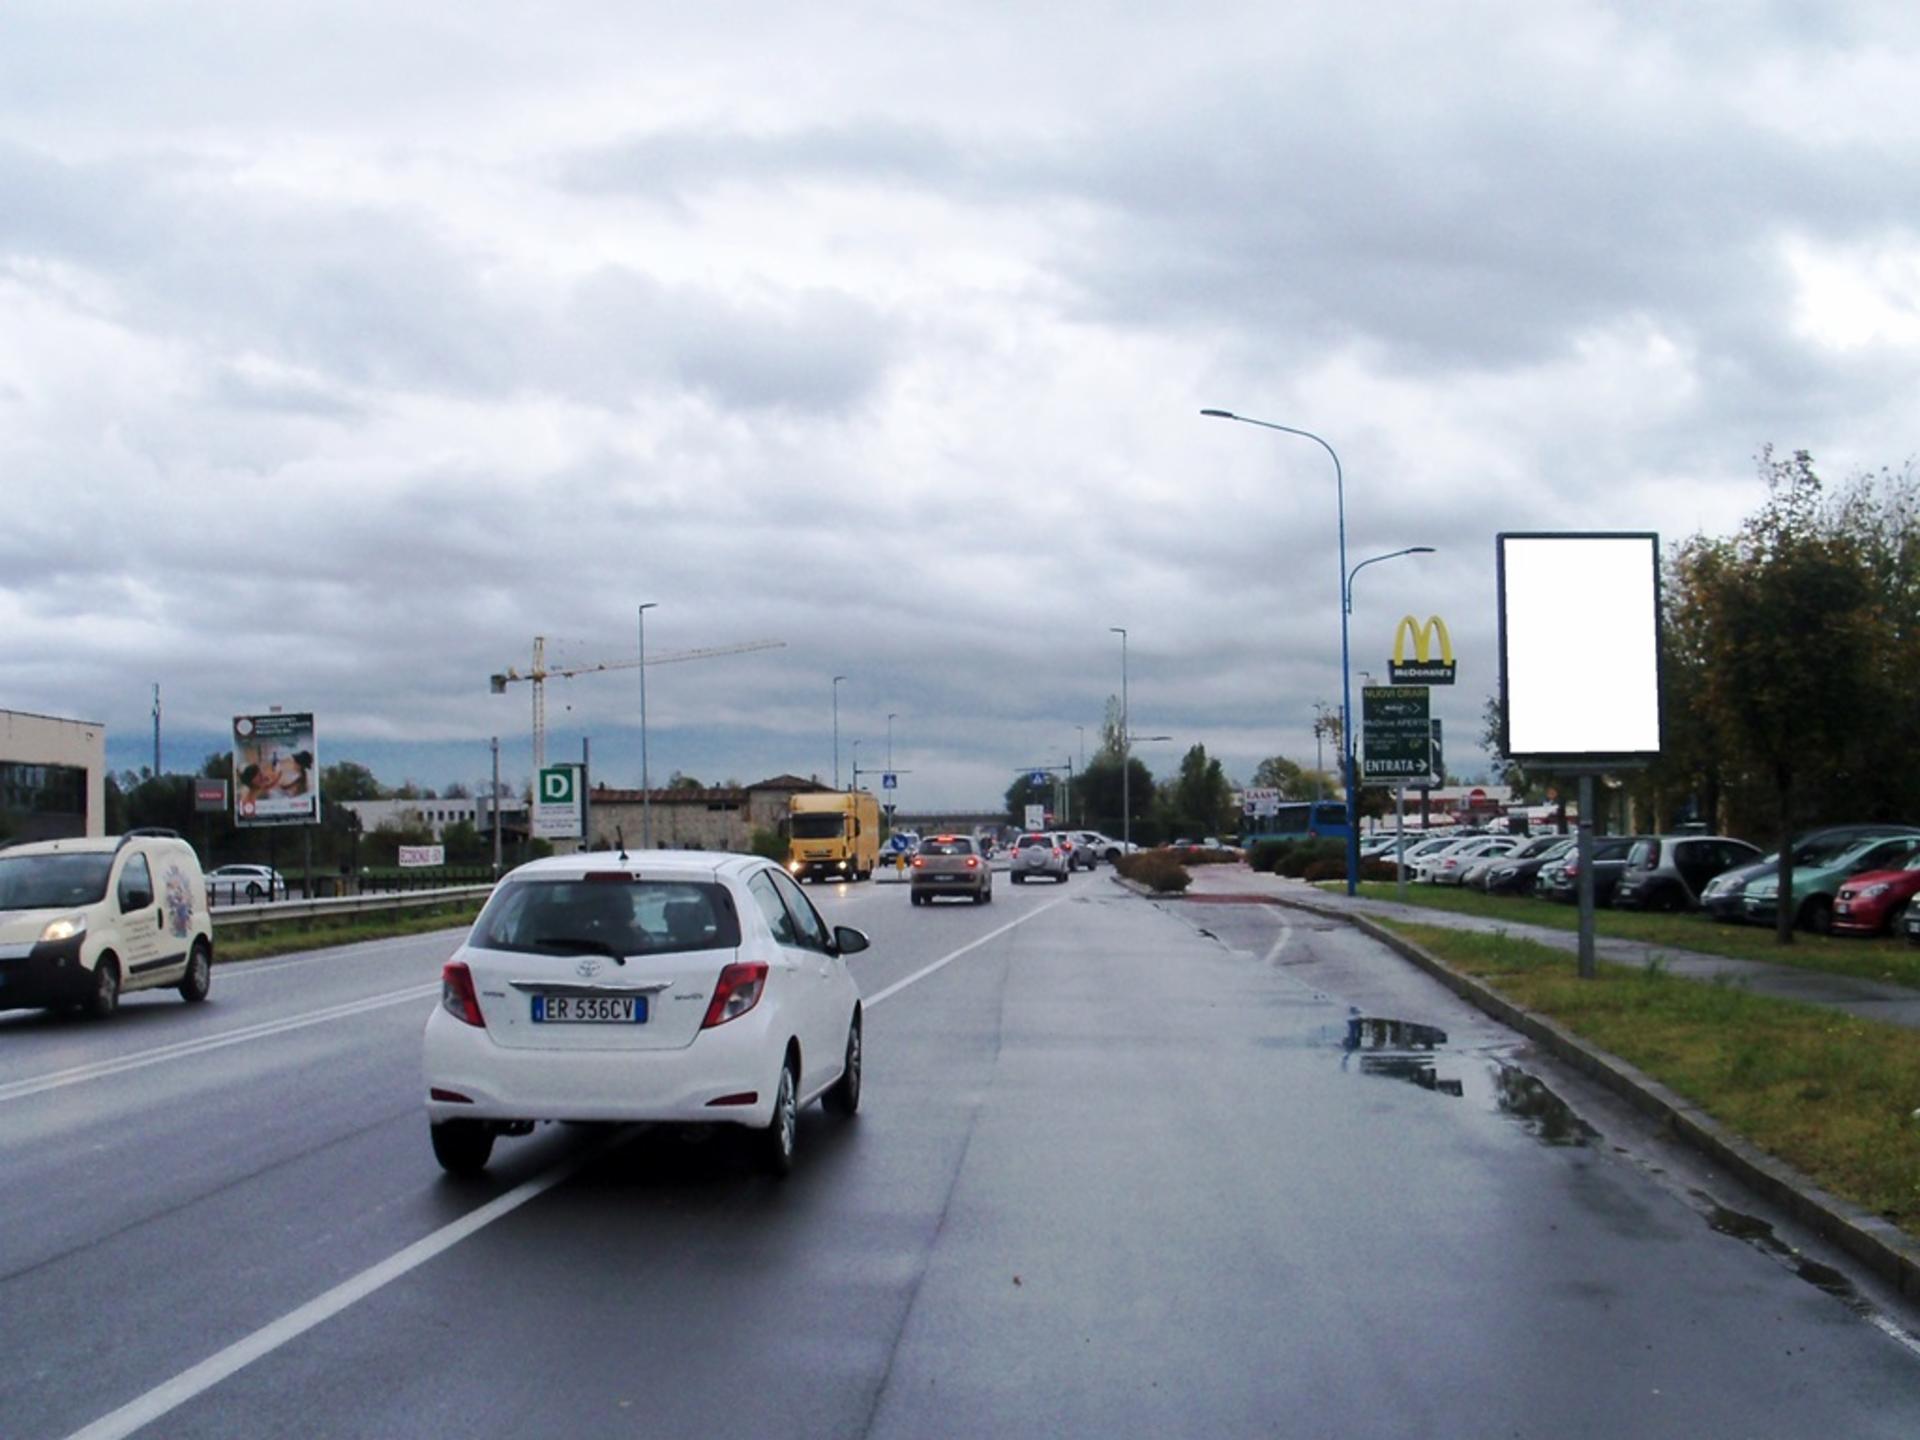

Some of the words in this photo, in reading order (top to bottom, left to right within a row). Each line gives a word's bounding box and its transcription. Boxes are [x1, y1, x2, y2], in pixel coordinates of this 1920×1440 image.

[1394, 667, 1452, 678] McDonald's
[1366, 759, 1414, 772] ENTRATA
[545, 773, 569, 798] D
[545, 998, 568, 1019] ER
[575, 998, 633, 1019] 536CV
